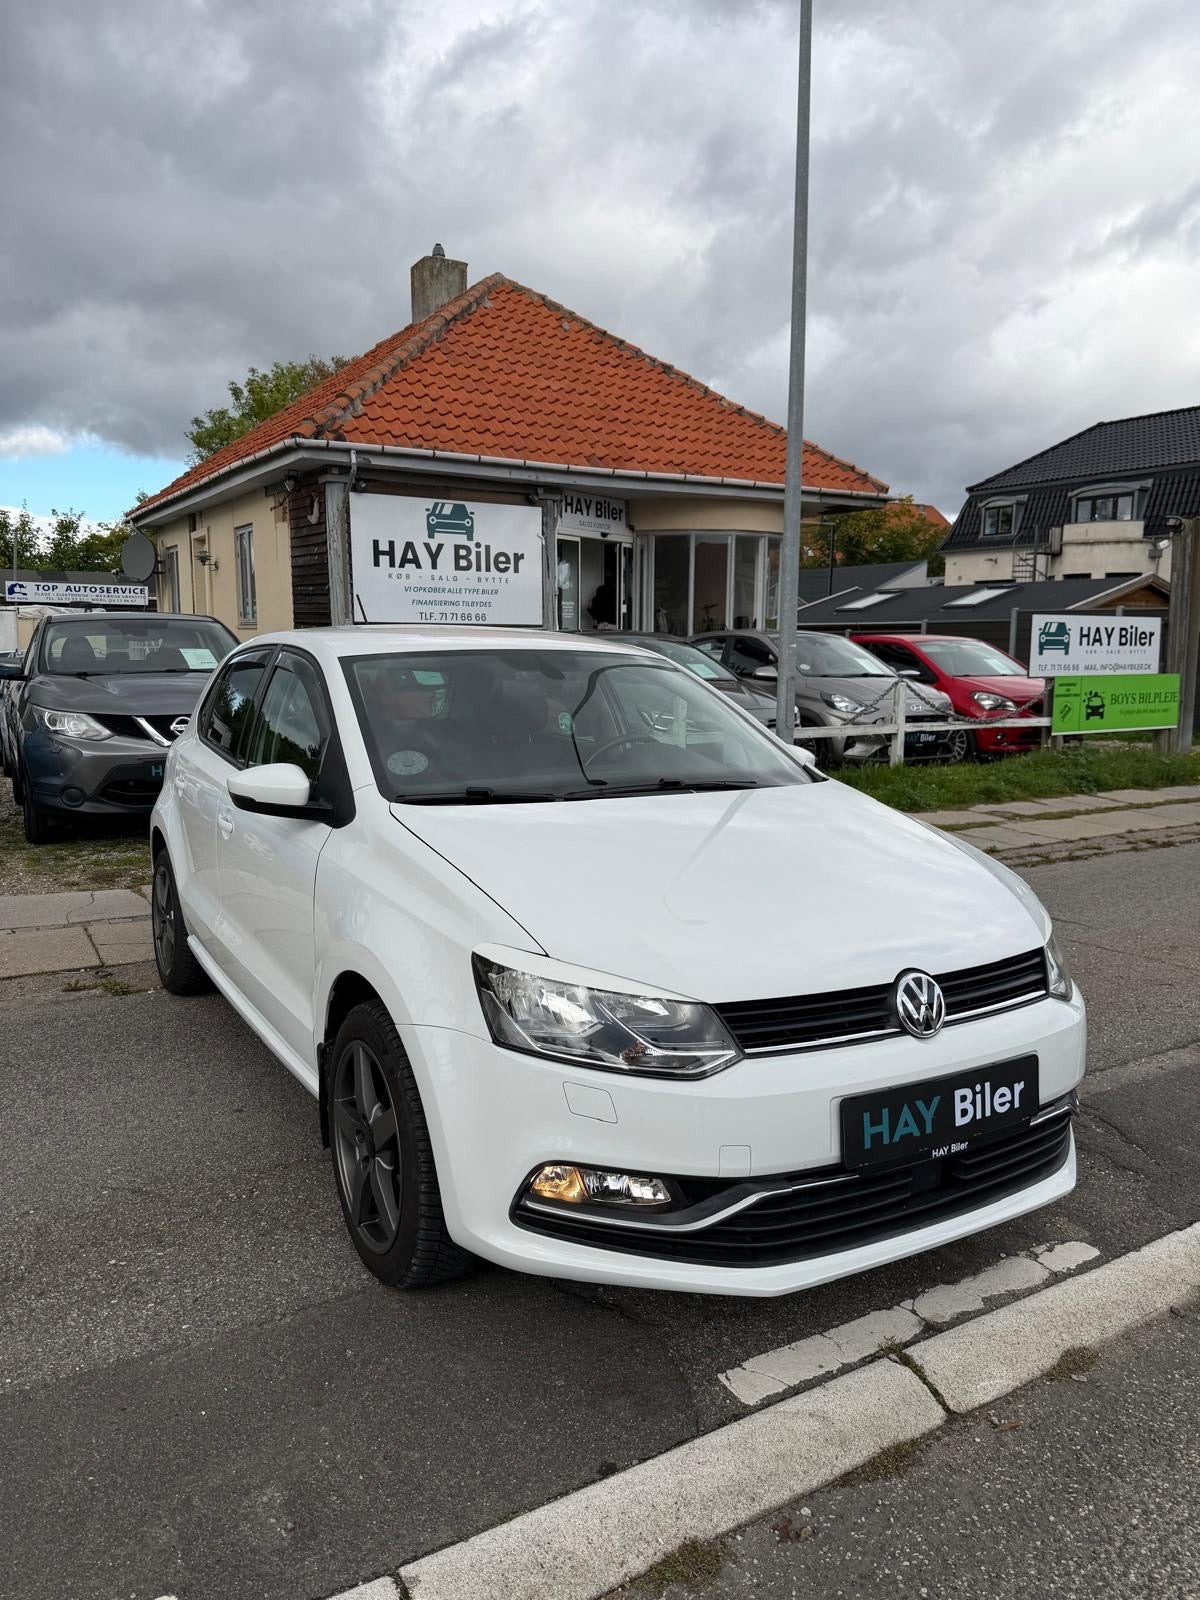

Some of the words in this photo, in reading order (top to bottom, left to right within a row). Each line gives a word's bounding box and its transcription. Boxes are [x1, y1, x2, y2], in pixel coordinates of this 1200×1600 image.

[564, 495, 593, 517] HAY
[595, 500, 624, 522] Biler
[372, 539, 445, 570] HAY
[453, 541, 525, 574] Biler
[477, 576, 509, 584] BYTTE
[35, 584, 58, 592] TOP
[65, 585, 145, 595] AUTOSERVICE
[481, 588, 499, 596] BILER
[411, 599, 460, 607] FINANSIERING
[462, 600, 492, 608] TILBYDES
[419, 612, 437, 621] TLF.
[439, 612, 447, 621] 71
[450, 612, 458, 621] 71
[460, 613, 473, 621] 66
[475, 613, 487, 622] 66
[1079, 626, 1115, 647] HAY
[1118, 625, 1155, 647] Biler
[1110, 692, 1136, 705] BOYS
[862, 1095, 941, 1149] HAY
[954, 1080, 1025, 1127] Biler
[932, 1146, 950, 1158] HAY
[951, 1141, 969, 1153] Biler
